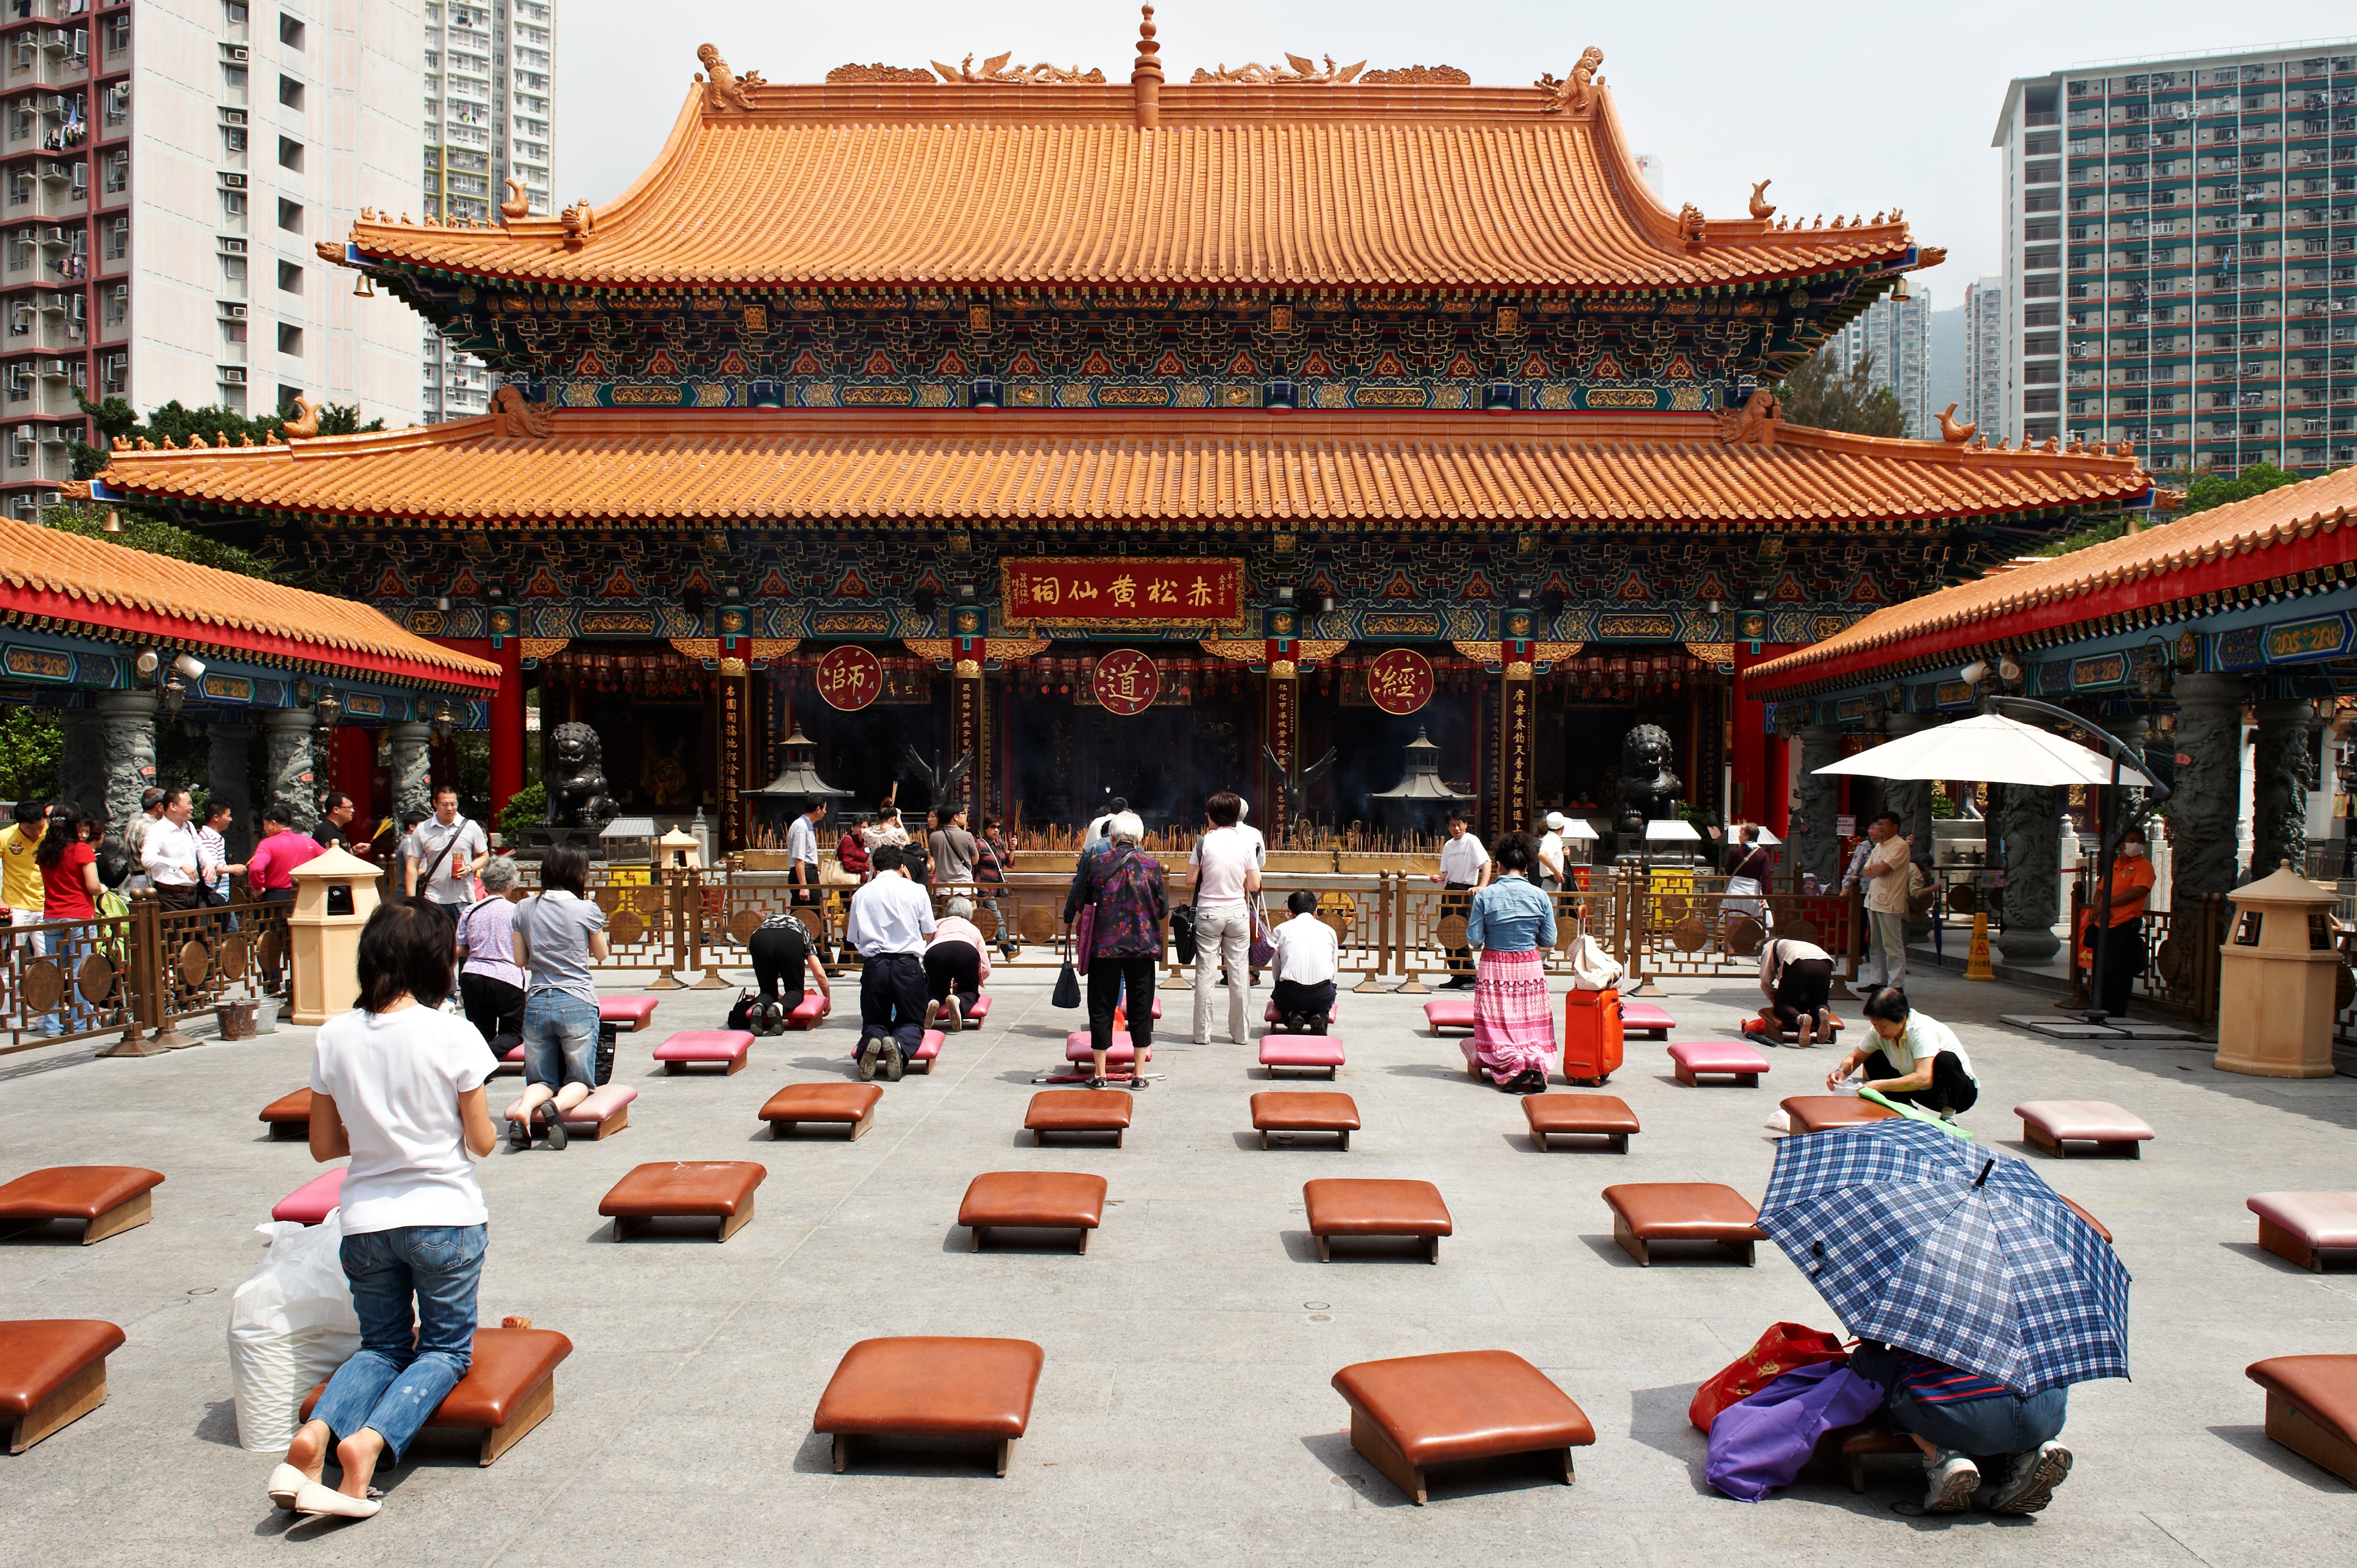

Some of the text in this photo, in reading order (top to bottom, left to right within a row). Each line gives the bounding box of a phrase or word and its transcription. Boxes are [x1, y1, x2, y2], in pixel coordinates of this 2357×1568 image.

[832, 660, 865, 697] 師
[1106, 662, 1144, 703] 道
[1381, 665, 1416, 698] 經
